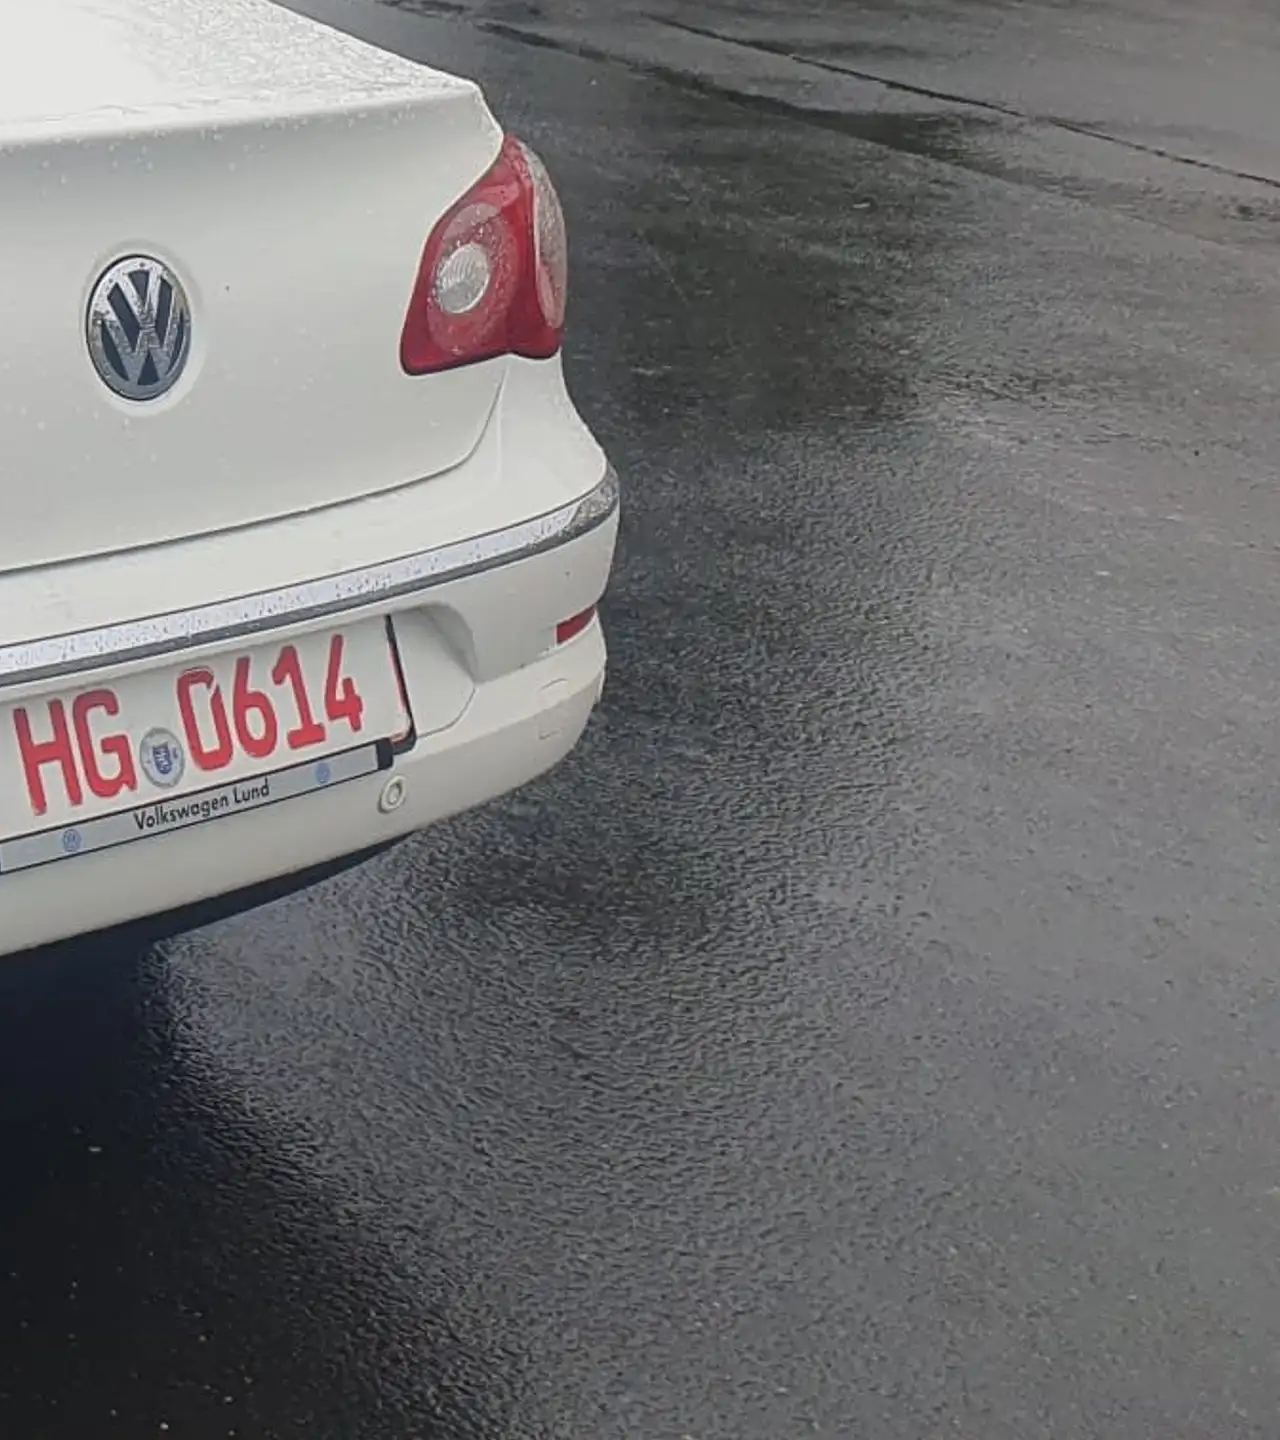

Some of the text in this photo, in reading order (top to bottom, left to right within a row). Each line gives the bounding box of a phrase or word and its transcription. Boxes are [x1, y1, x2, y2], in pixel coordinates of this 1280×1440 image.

[12, 633, 364, 817] HG 0614
[133, 777, 270, 830] Volkswagen Lund
